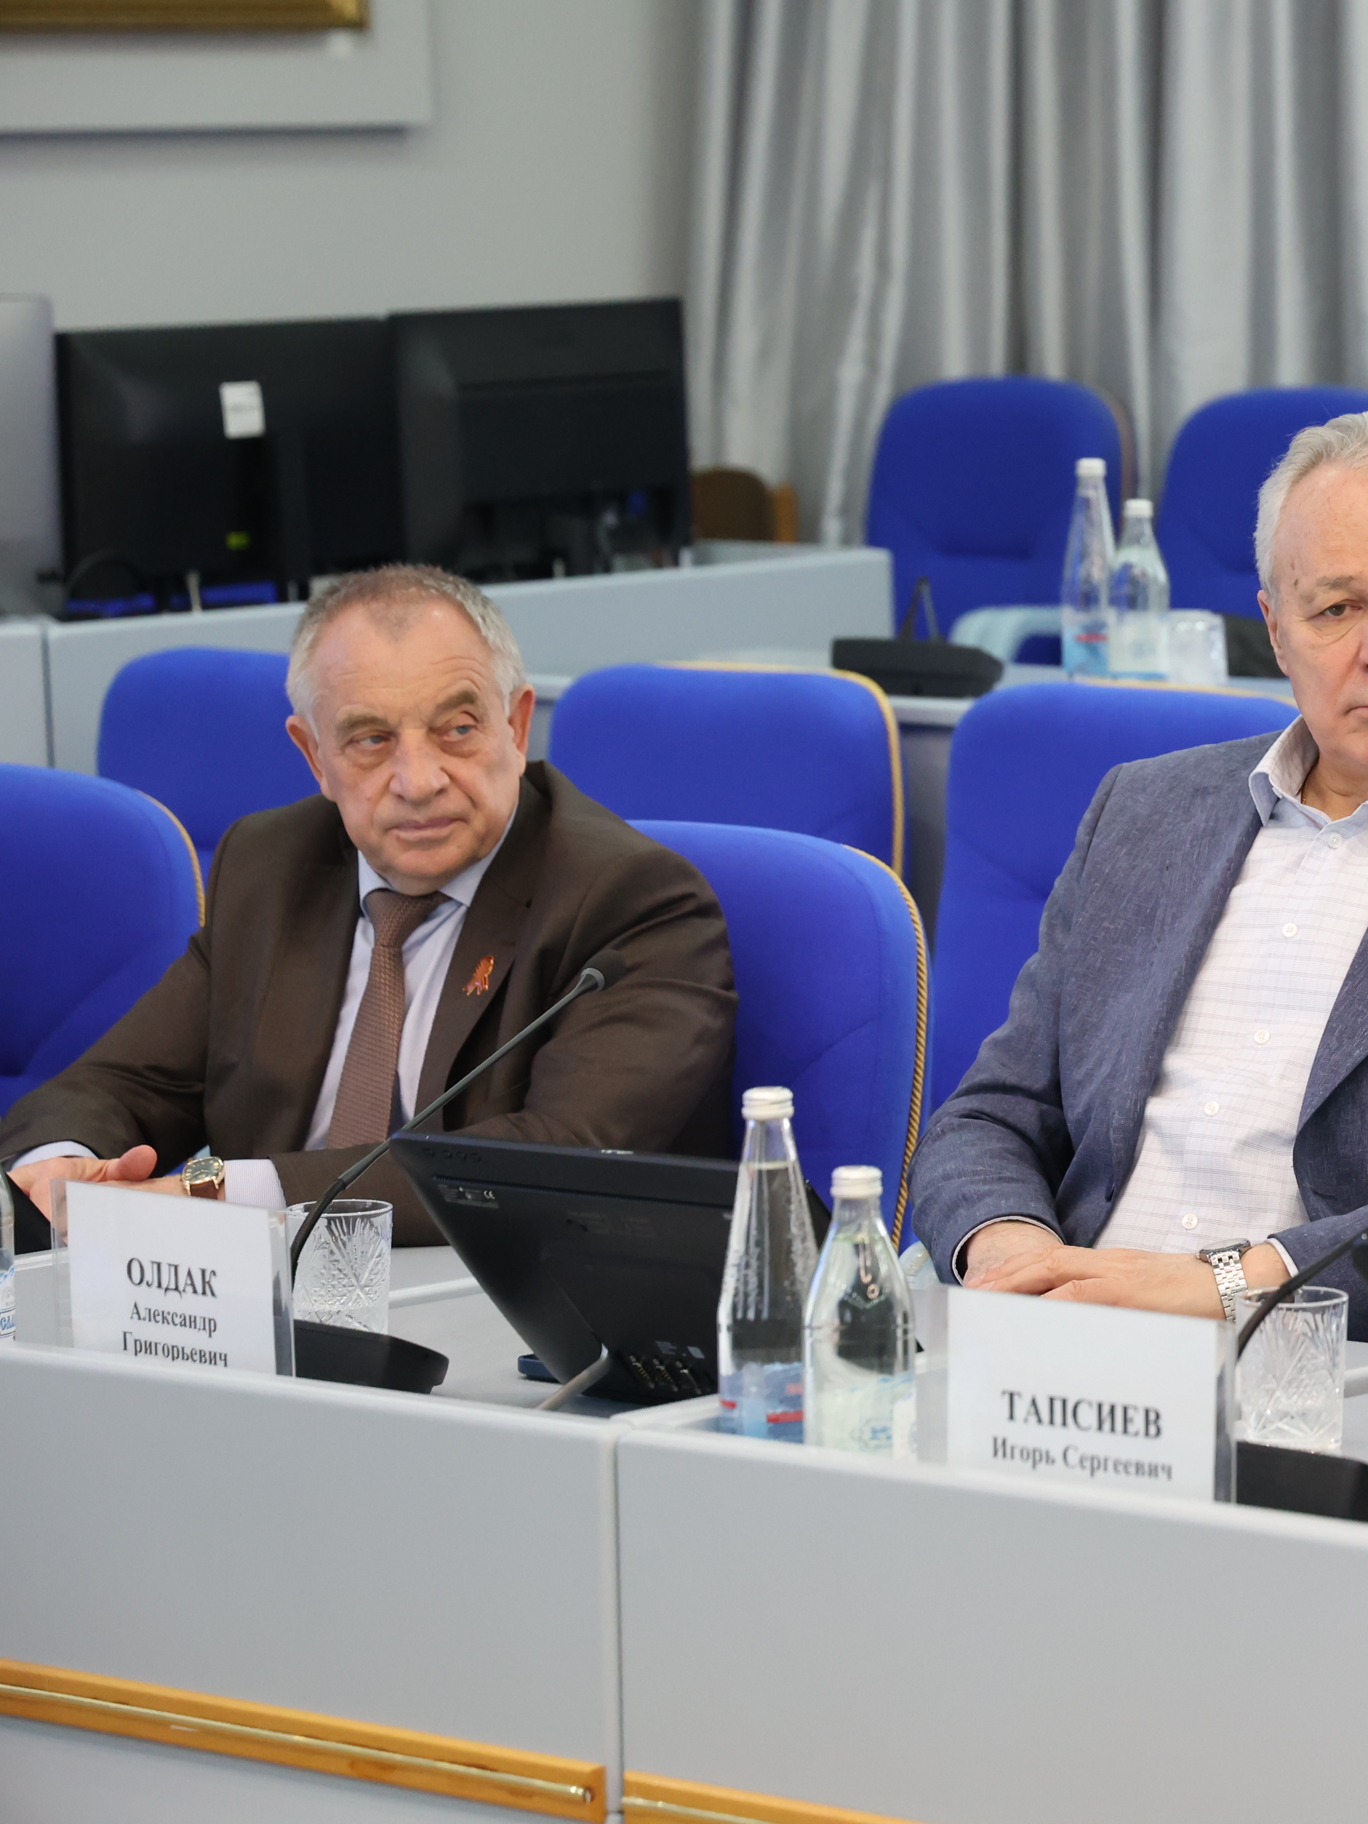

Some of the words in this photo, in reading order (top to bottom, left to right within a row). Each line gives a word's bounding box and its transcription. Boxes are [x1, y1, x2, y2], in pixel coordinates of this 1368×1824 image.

[126, 1257, 218, 1299] ОЛДАК
[130, 1300, 218, 1338] Александр
[122, 1330, 229, 1367] Григорьевич
[1001, 1389, 1162, 1439] ТАПСИЕВ
[992, 1436, 1056, 1470] Игорь
[1062, 1444, 1173, 1481] Сергеевич
